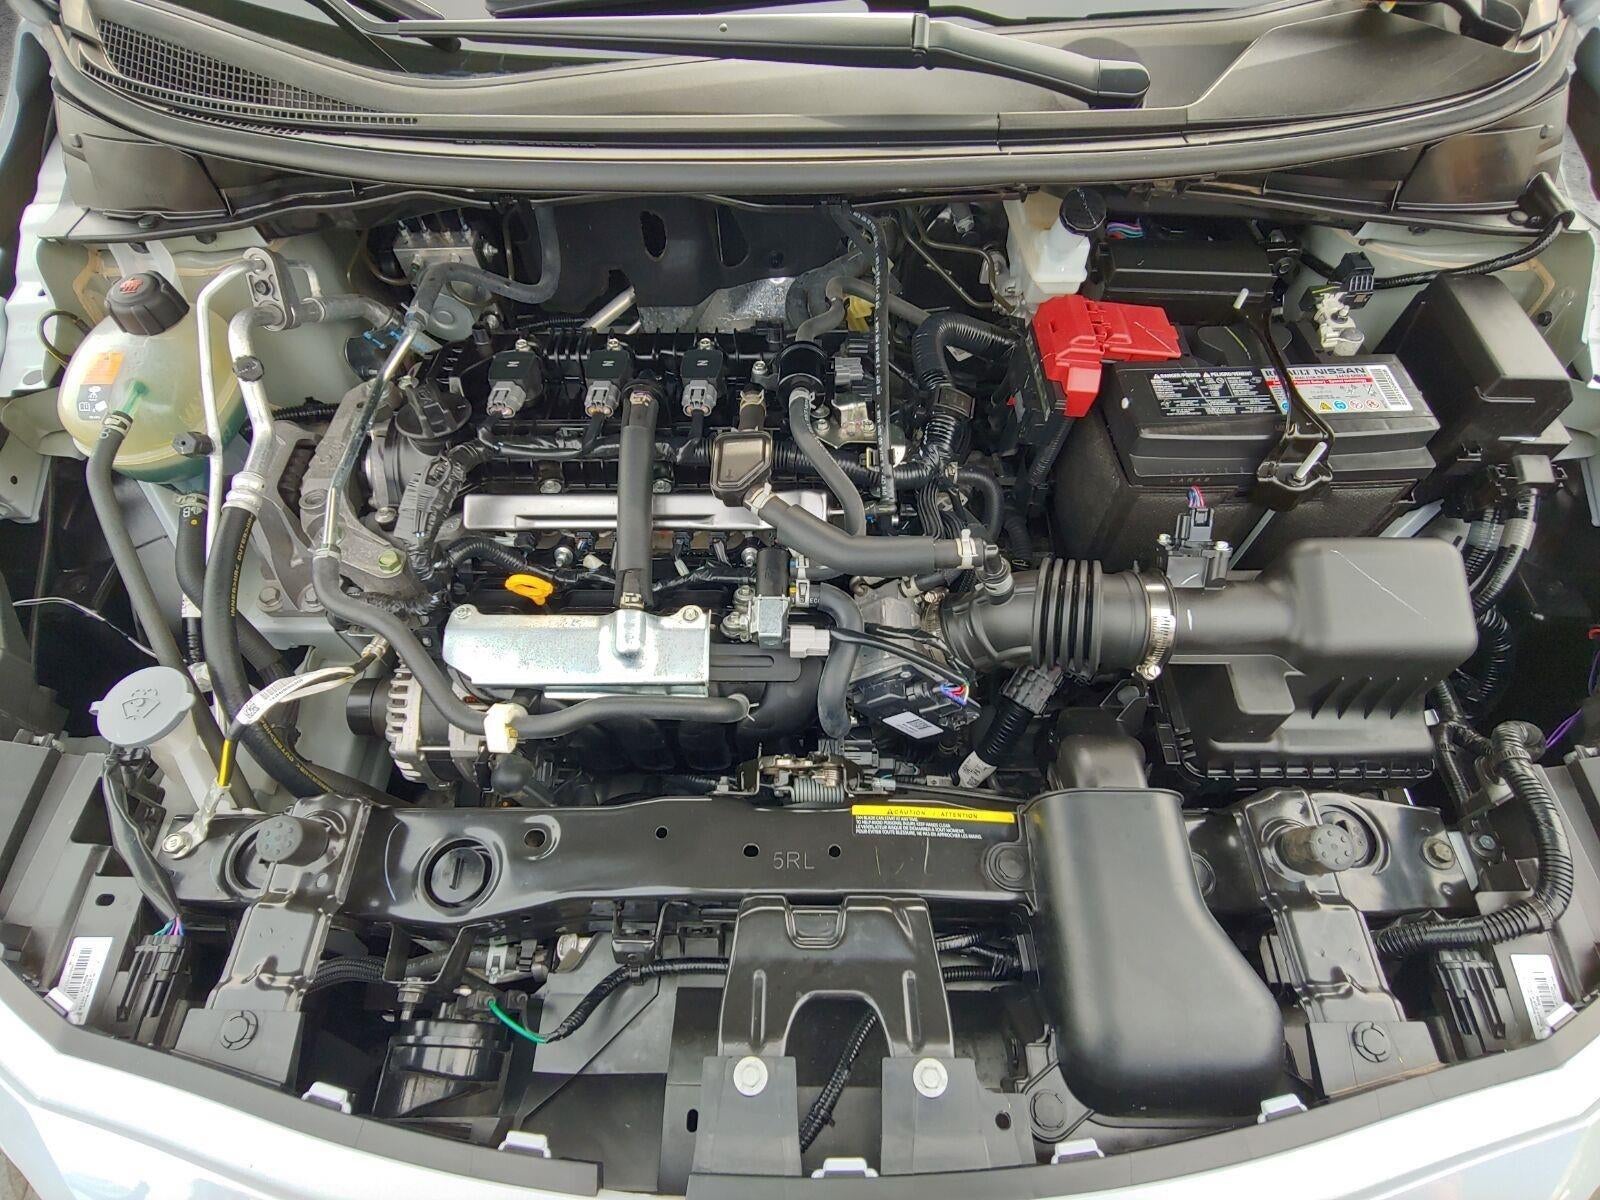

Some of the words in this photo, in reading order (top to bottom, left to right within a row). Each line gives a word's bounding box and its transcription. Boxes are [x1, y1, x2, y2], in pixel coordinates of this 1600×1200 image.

[1314, 367, 1365, 376] NISSAN
[940, 811, 978, 819] ATTENTION
[773, 850, 816, 870] 5RL
